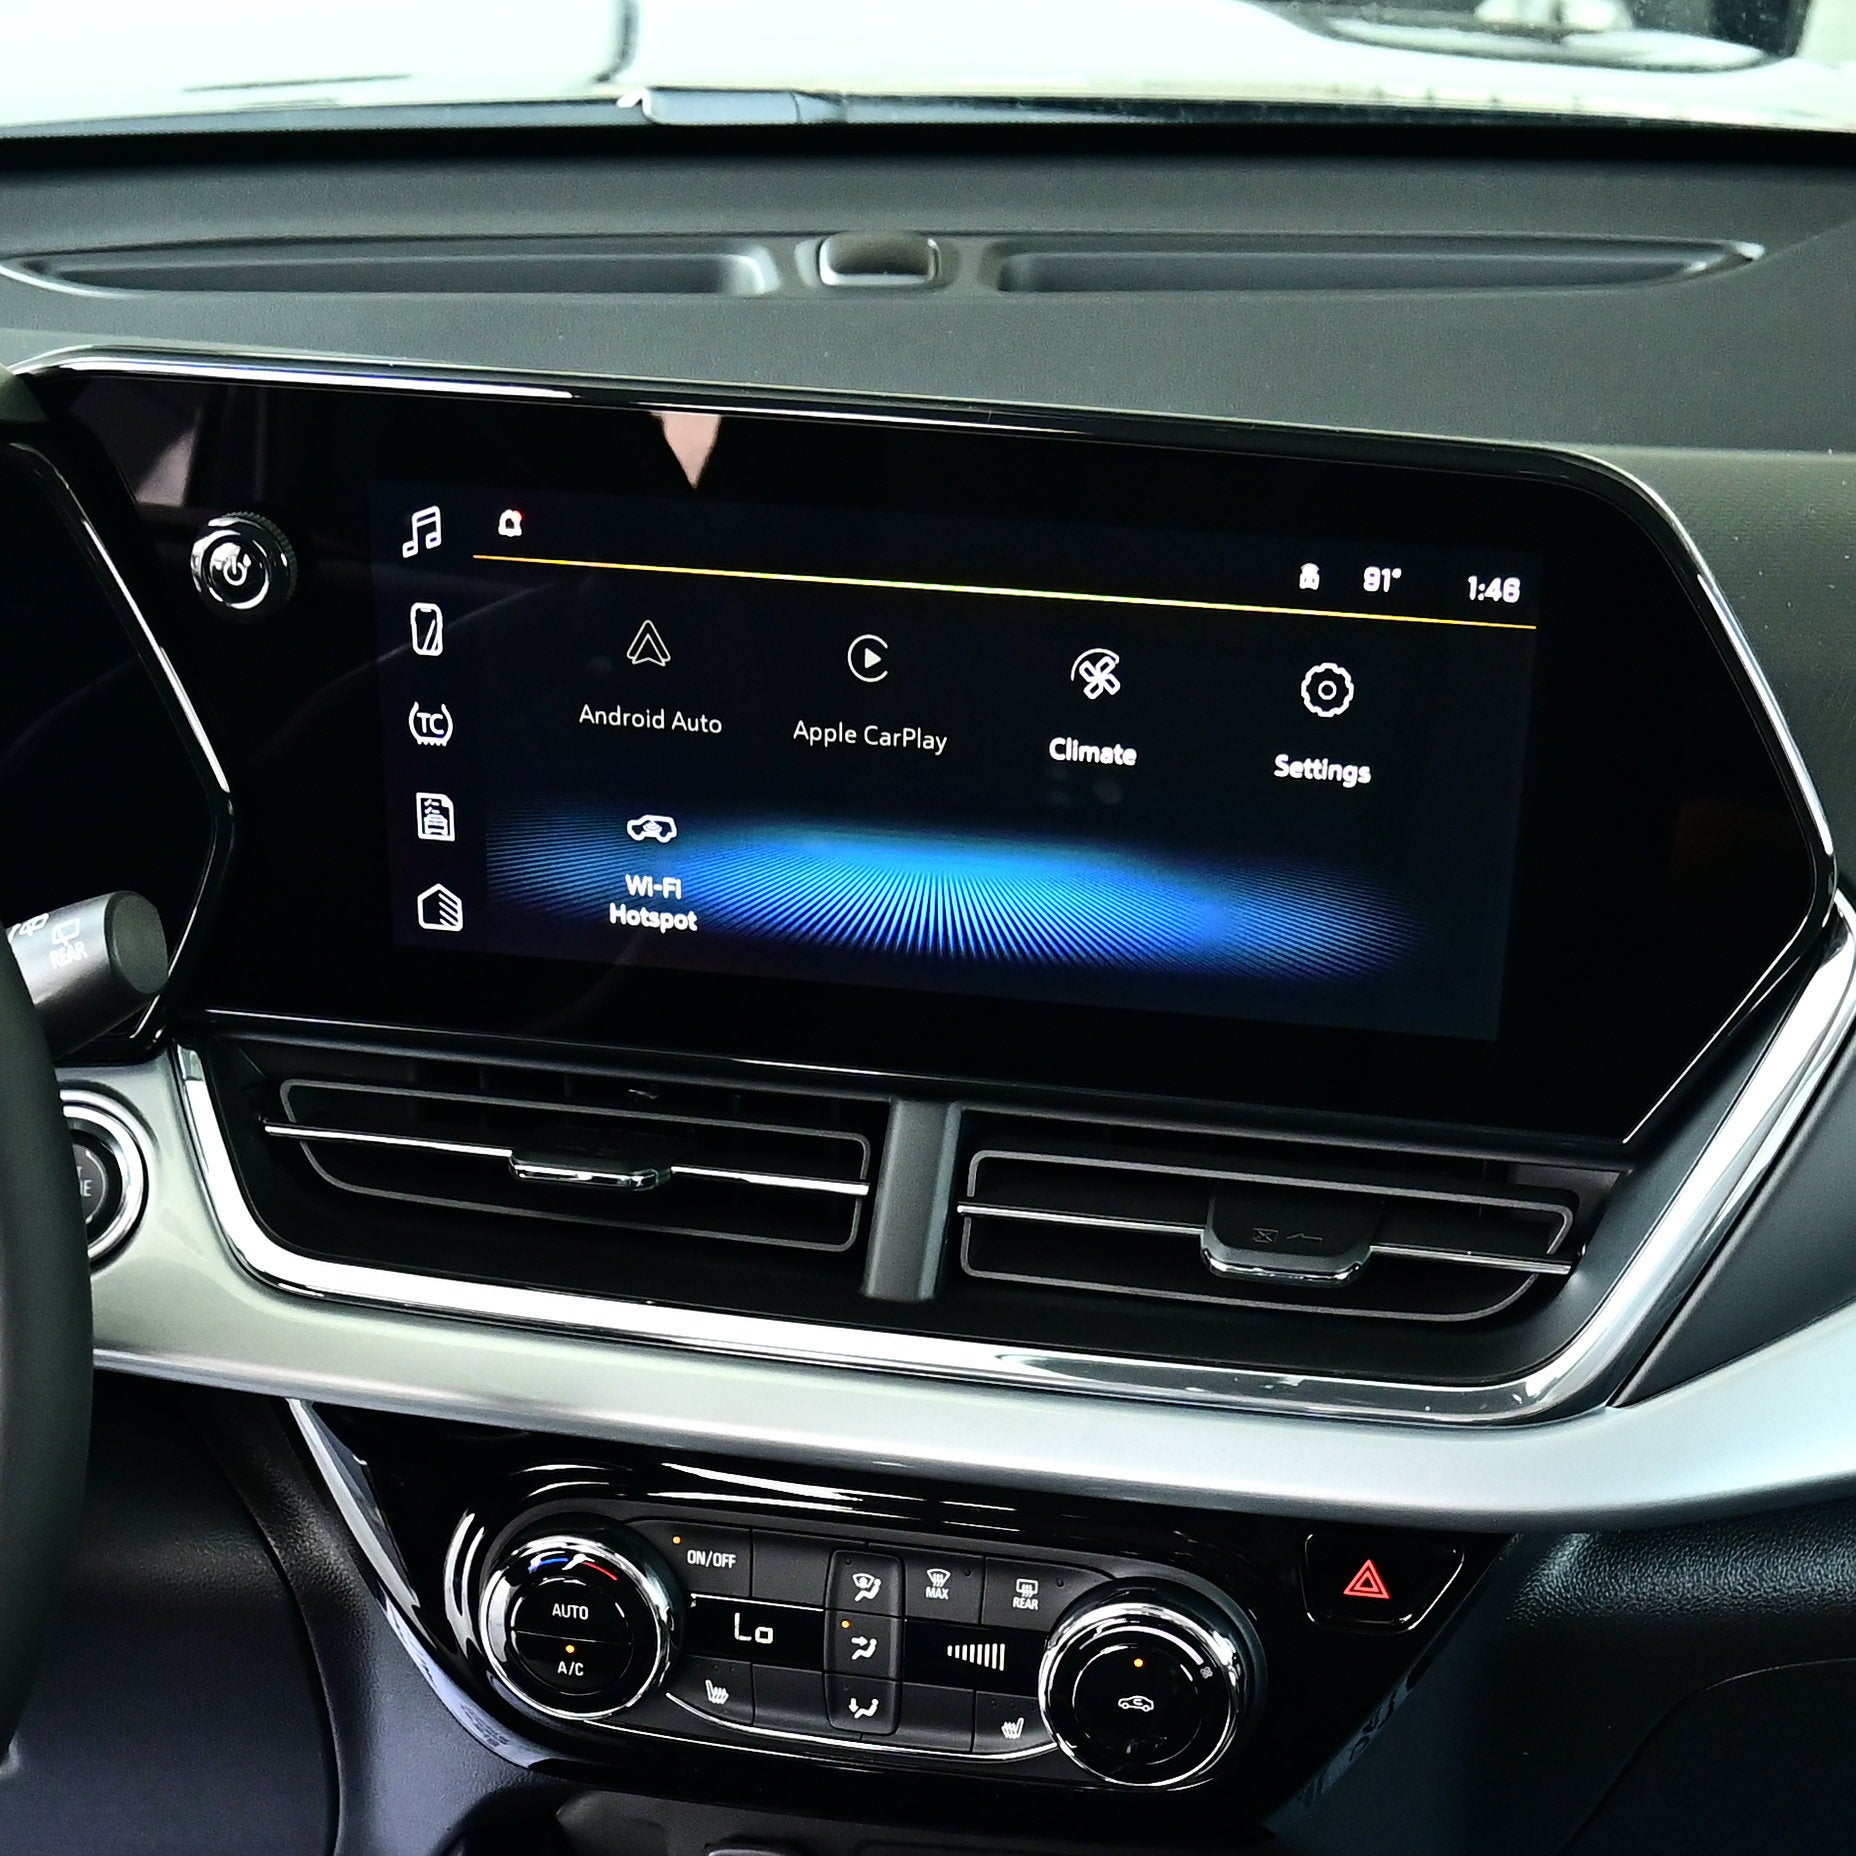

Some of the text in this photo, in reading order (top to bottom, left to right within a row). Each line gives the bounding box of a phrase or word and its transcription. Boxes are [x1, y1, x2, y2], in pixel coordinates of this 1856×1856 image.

[1468, 576, 1520, 603] 1:46
[417, 713, 444, 735] TC
[579, 704, 721, 733] Android Auto
[794, 720, 947, 755] Apple CarPlay
[1049, 737, 1137, 765] Climate
[1274, 754, 1371, 788] Settings
[625, 874, 682, 899] Wi-Fi
[609, 903, 698, 932] Hotspot
[49, 941, 89, 969] REAR
[688, 1550, 736, 1568] ON/OFF
[926, 1587, 948, 1599] MAX
[1013, 1596, 1038, 1610] REAR
[552, 1604, 588, 1620] AUTO
[558, 1661, 583, 1676] A/C
